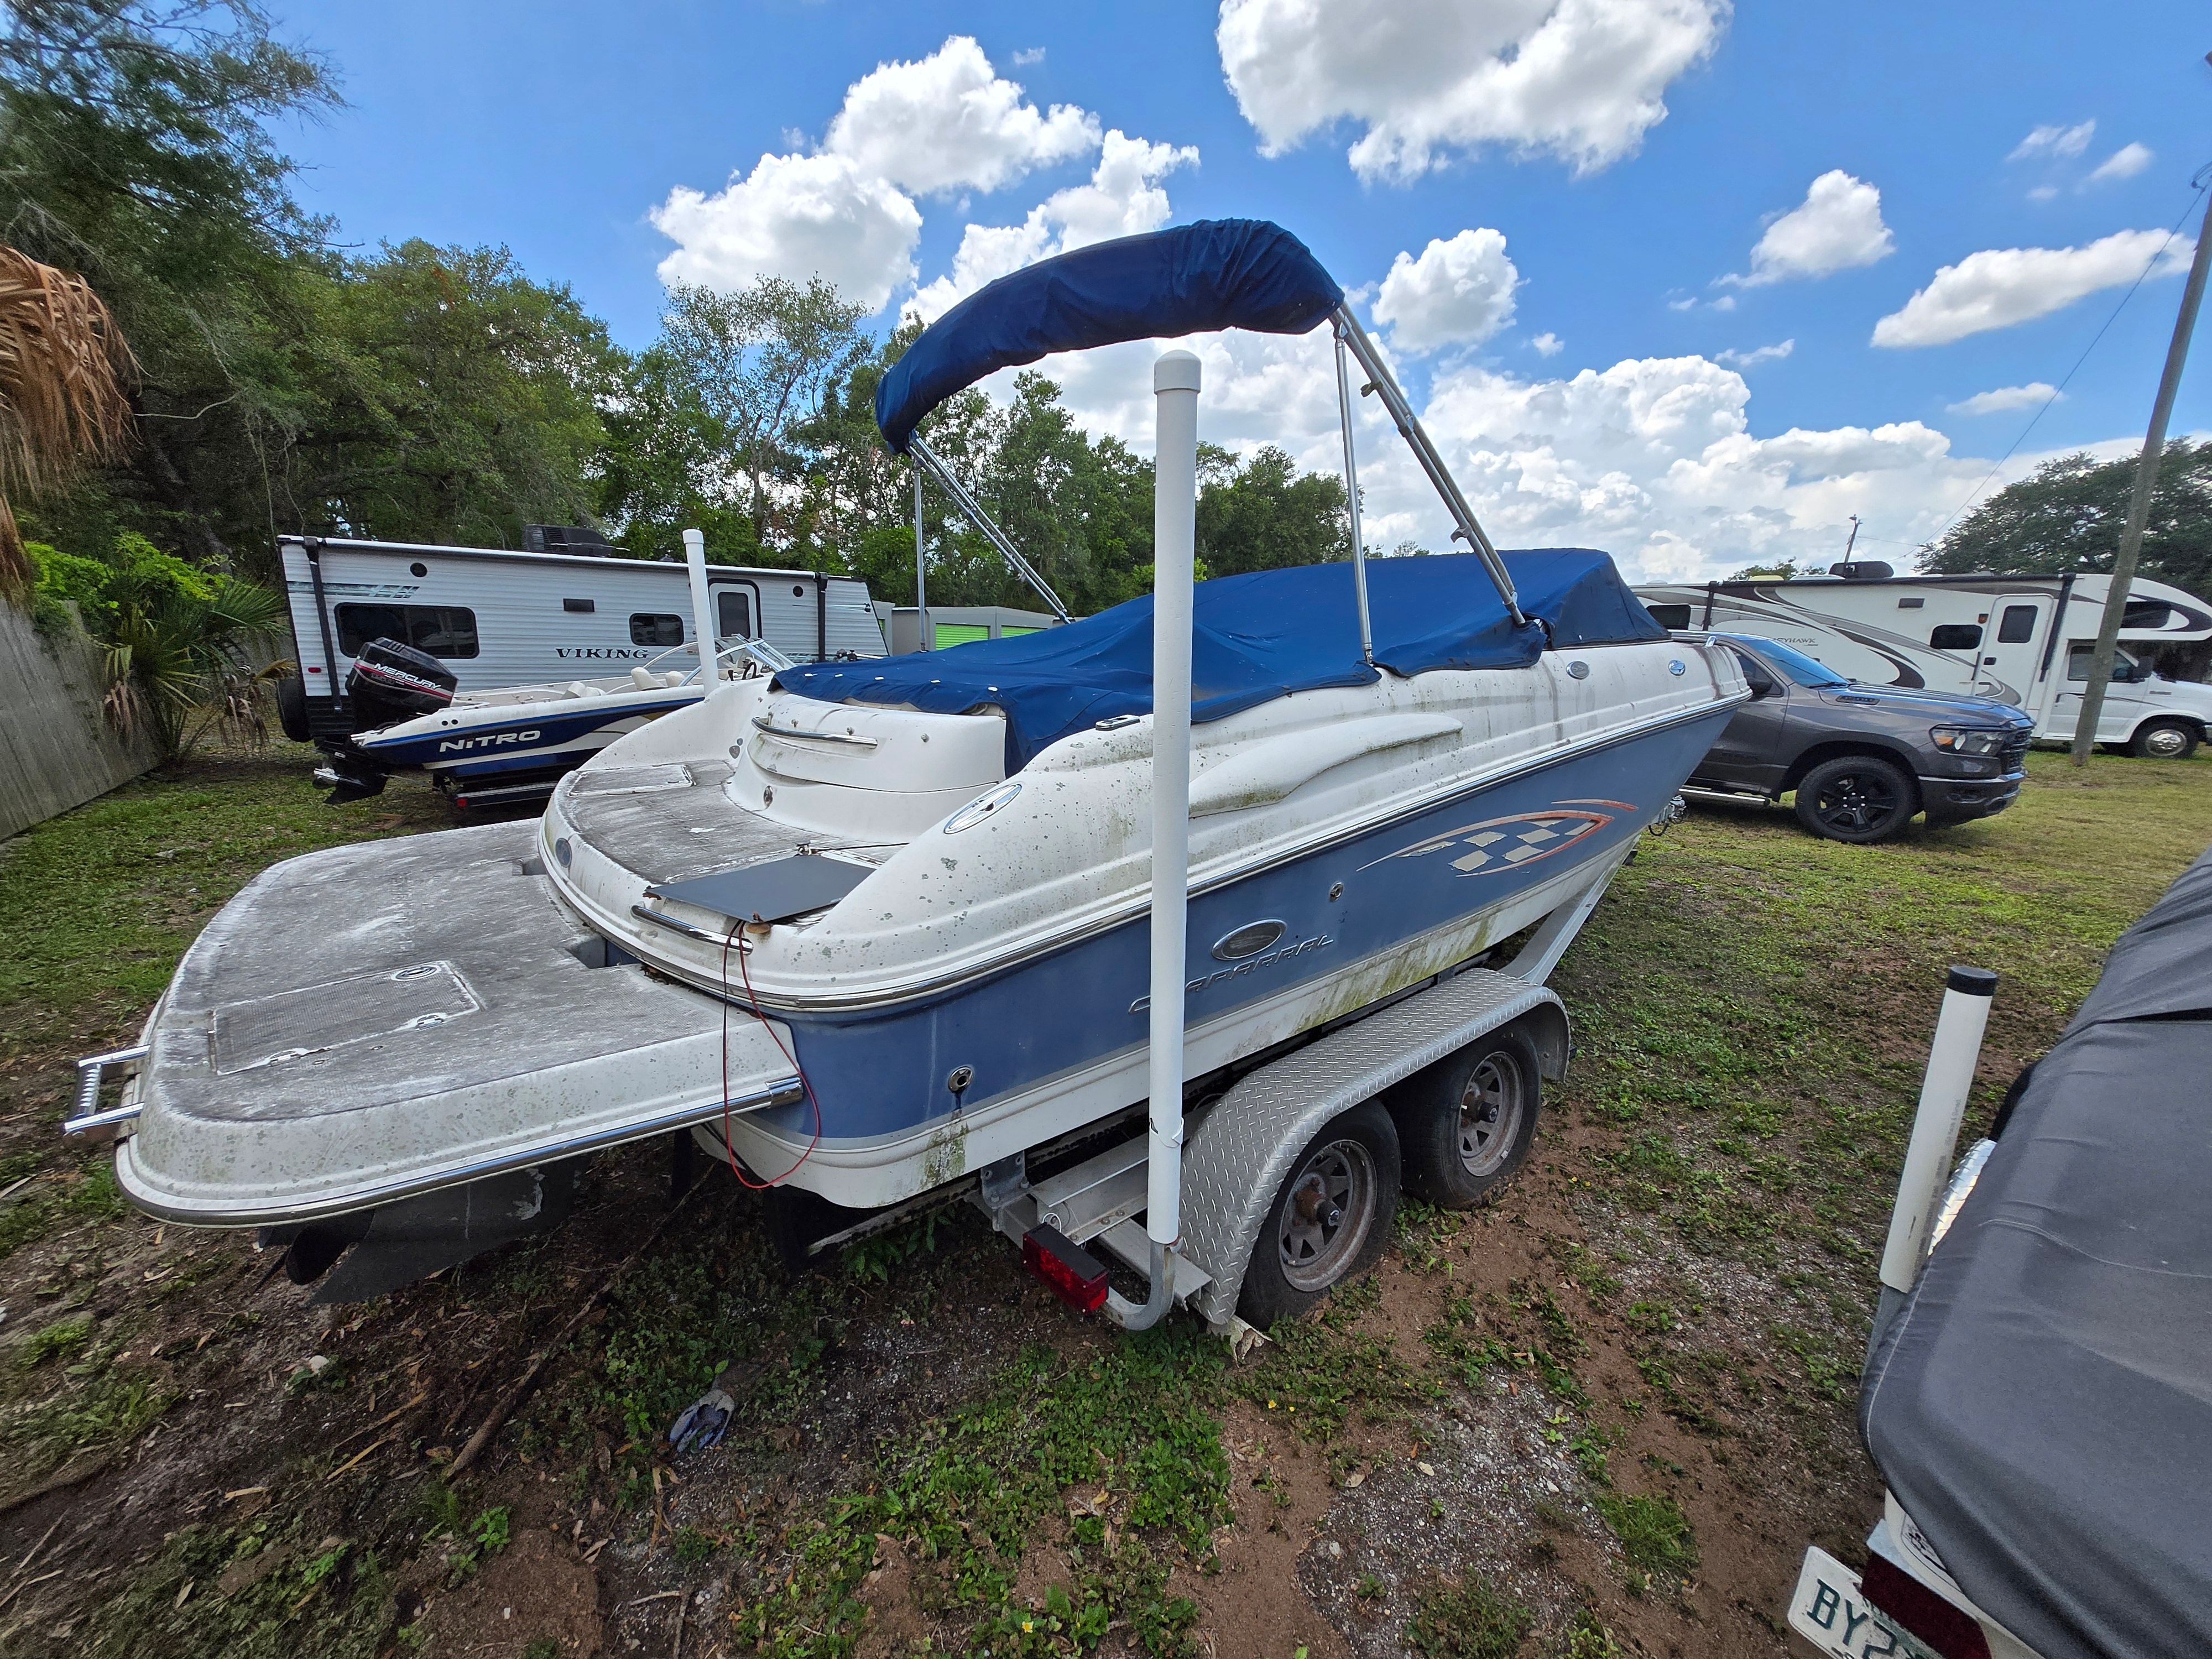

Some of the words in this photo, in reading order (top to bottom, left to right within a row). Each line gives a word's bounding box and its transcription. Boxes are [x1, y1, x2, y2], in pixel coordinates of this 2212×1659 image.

[555, 648, 649, 659] VIKING
[374, 663, 441, 690] MERCURY
[1128, 935, 1334, 1014] CAPARRAL
